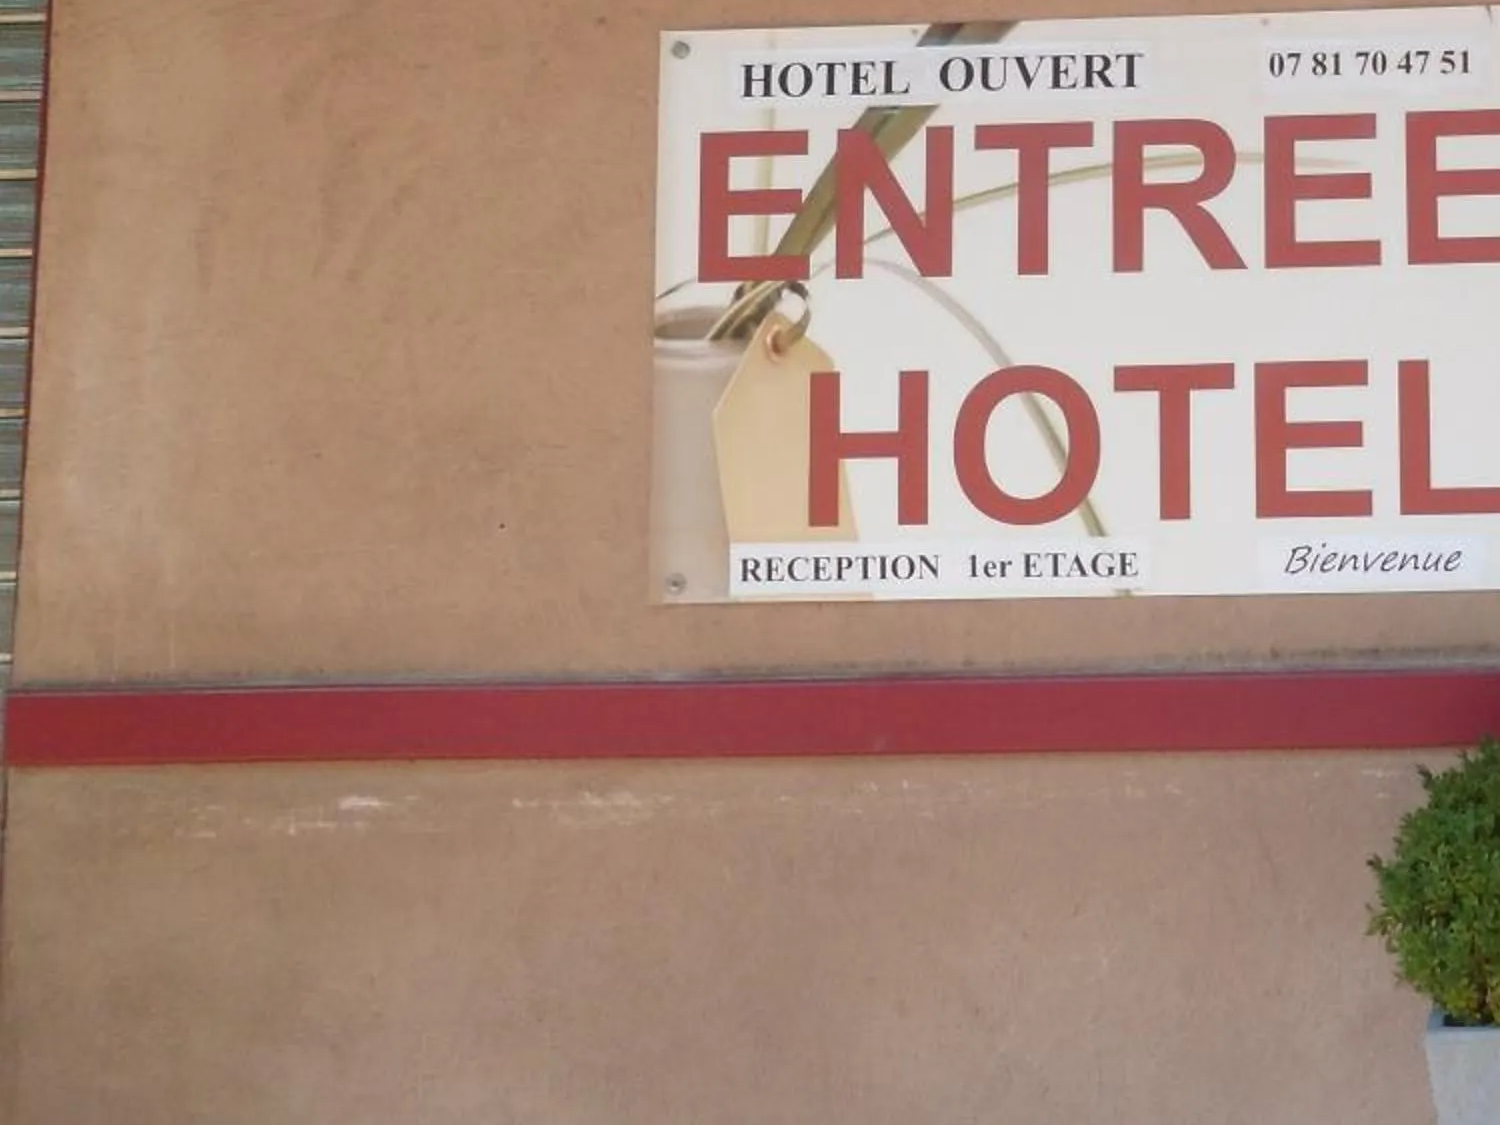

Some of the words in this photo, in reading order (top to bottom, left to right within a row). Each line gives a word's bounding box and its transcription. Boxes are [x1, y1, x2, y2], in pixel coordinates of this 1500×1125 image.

[741, 60, 911, 99] HOTEL
[938, 52, 1144, 92] OUVERT
[1269, 51, 1302, 78] 07
[1311, 51, 1343, 77] 81
[1355, 50, 1388, 76] 70
[1397, 49, 1431, 75] 47
[1440, 49, 1472, 74] 51
[740, 554, 940, 582] RECEPTION
[968, 553, 1013, 578] 1er
[1023, 552, 1140, 578] ETAGE
[1284, 542, 1463, 575] Bienvenue
